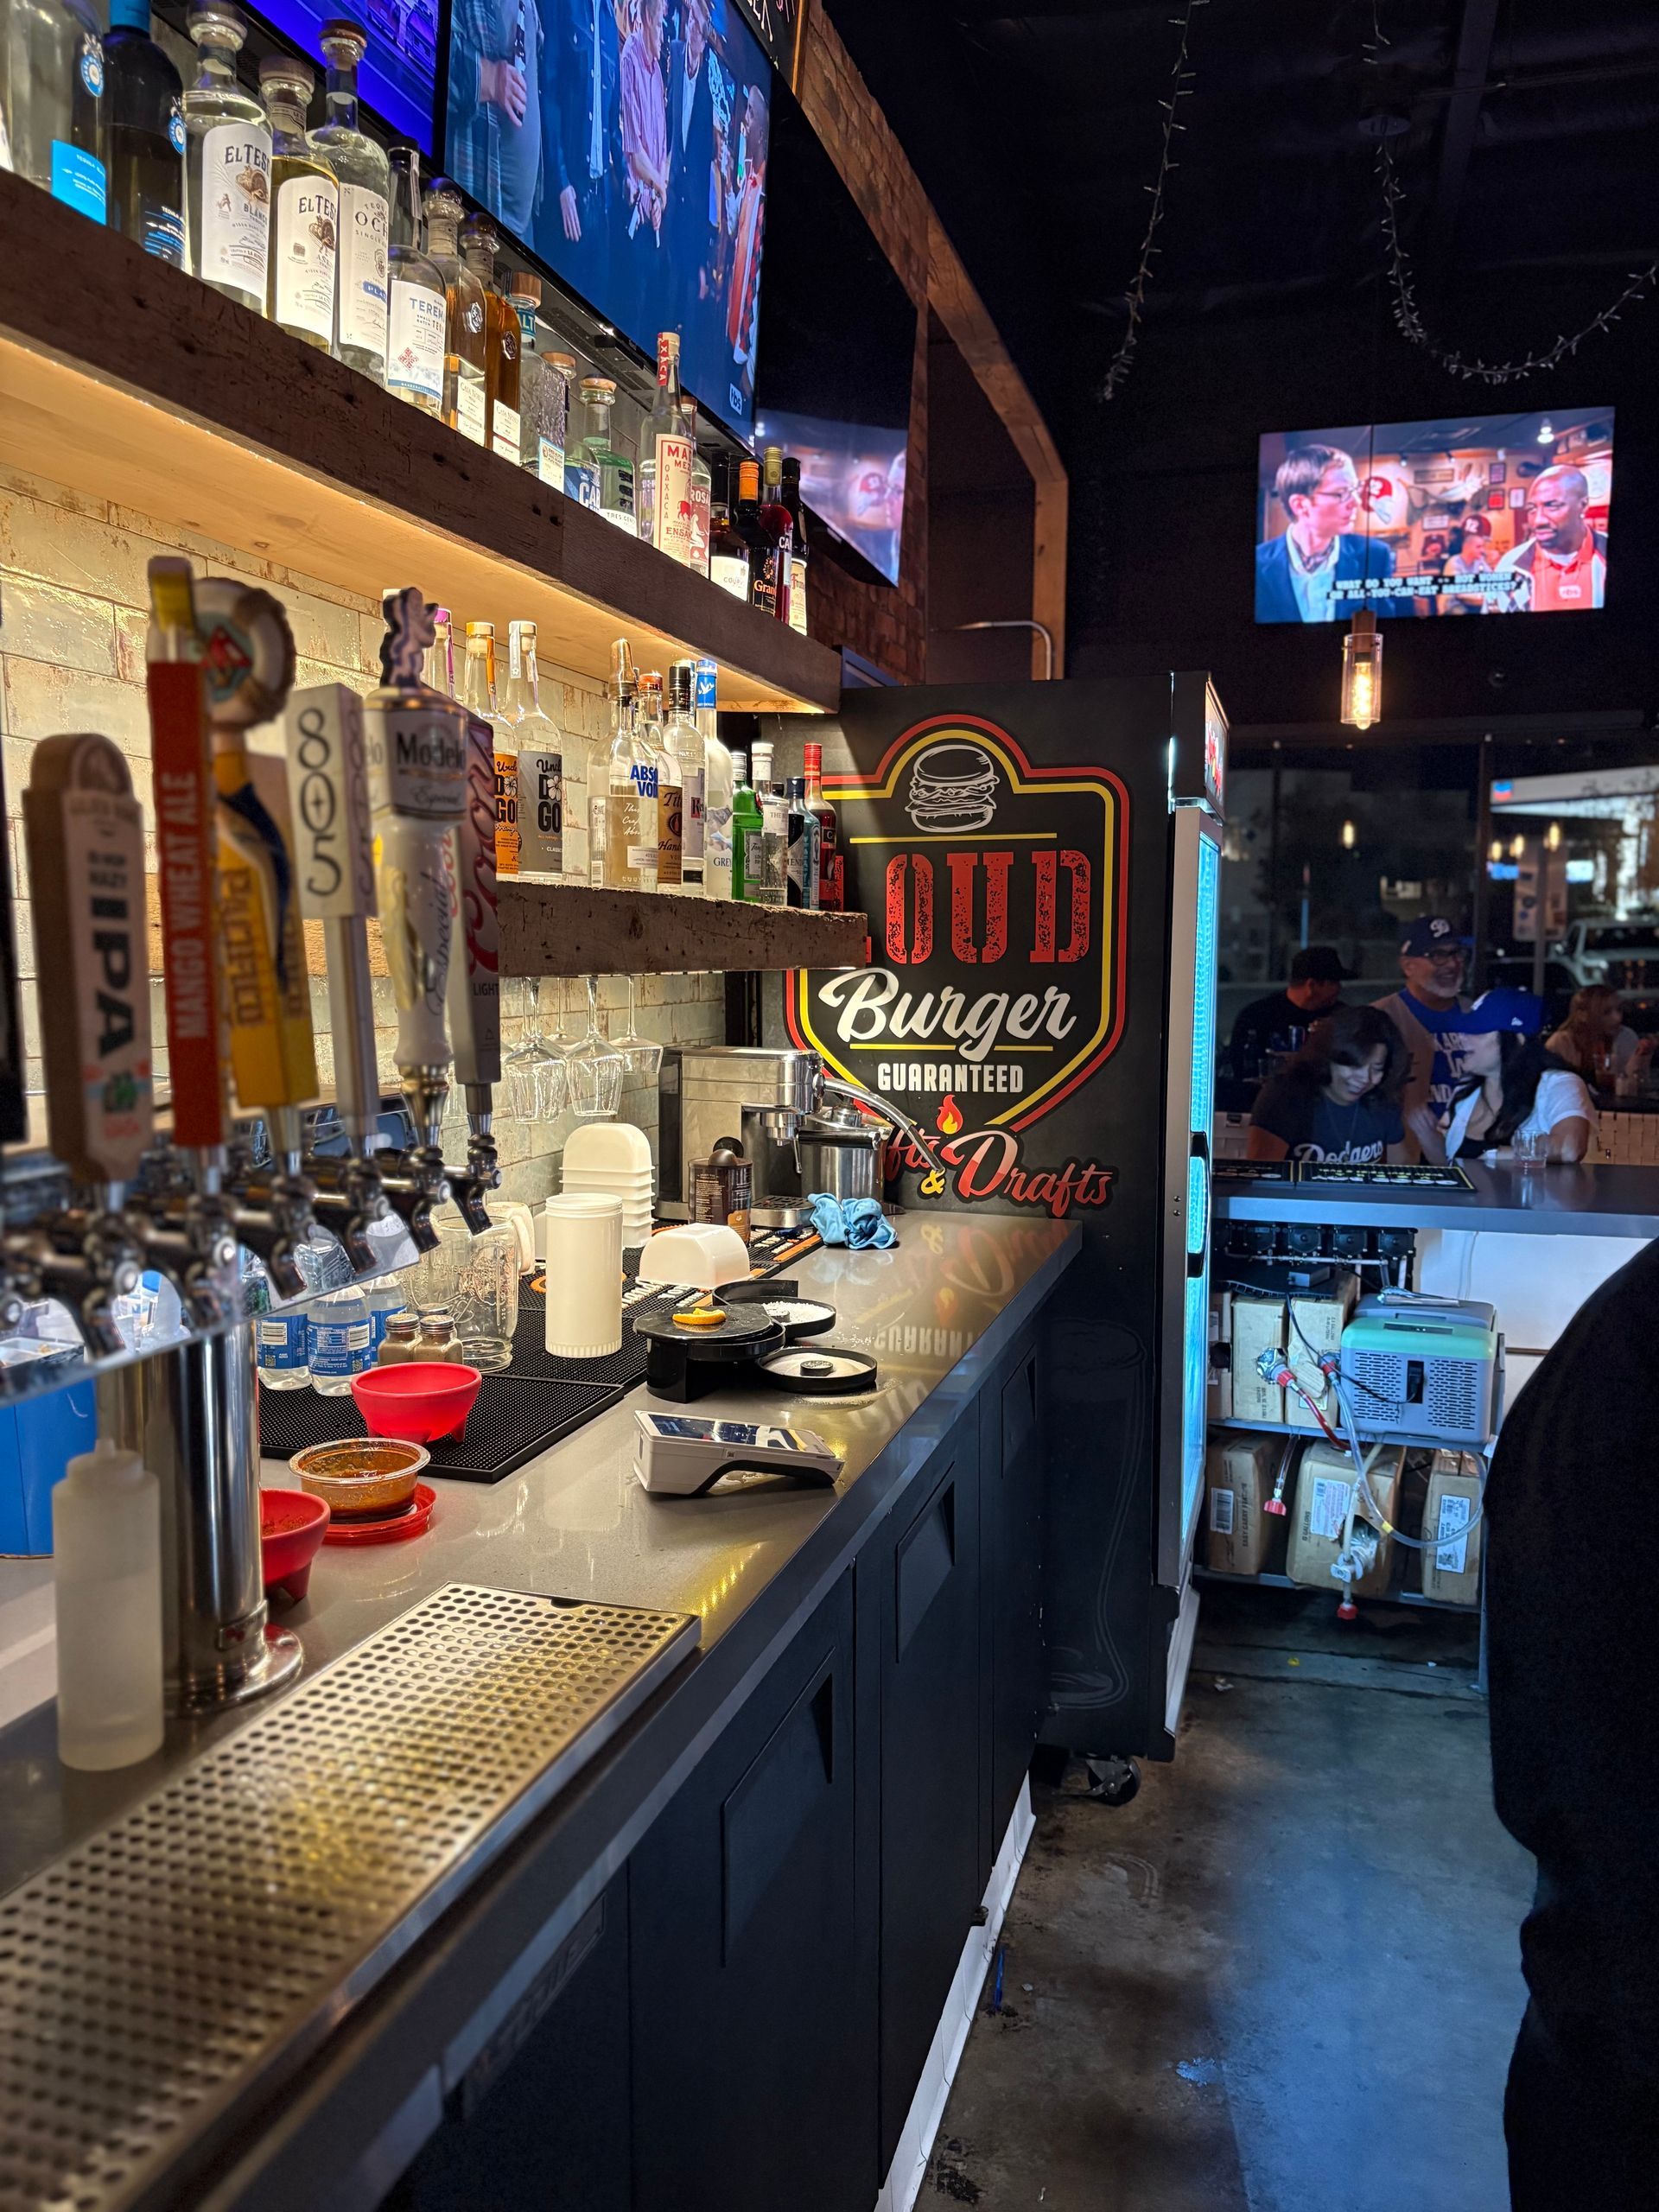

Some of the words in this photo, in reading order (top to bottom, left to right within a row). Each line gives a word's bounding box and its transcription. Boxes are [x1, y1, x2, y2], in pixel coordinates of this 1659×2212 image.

[225, 146, 243, 165] EL
[298, 197, 315, 214] EL
[779, 536, 793, 550] CA
[1336, 580, 1363, 590] WHAT
[1383, 578, 1402, 588] YOU
[1407, 576, 1433, 587] WANT
[395, 730, 467, 769] Modelo
[162, 771, 198, 825] ALE
[297, 707, 342, 898] 805
[165, 830, 204, 930] WHEAT
[89, 895, 137, 1060] IPA
[175, 937, 210, 1039] MANGO
[817, 968, 1077, 1062] Burger
[877, 1063, 1024, 1095] GUARANTEED
[939, 1130, 1114, 1218] Drafts
[1294, 1140, 1383, 1165] Dodgers
